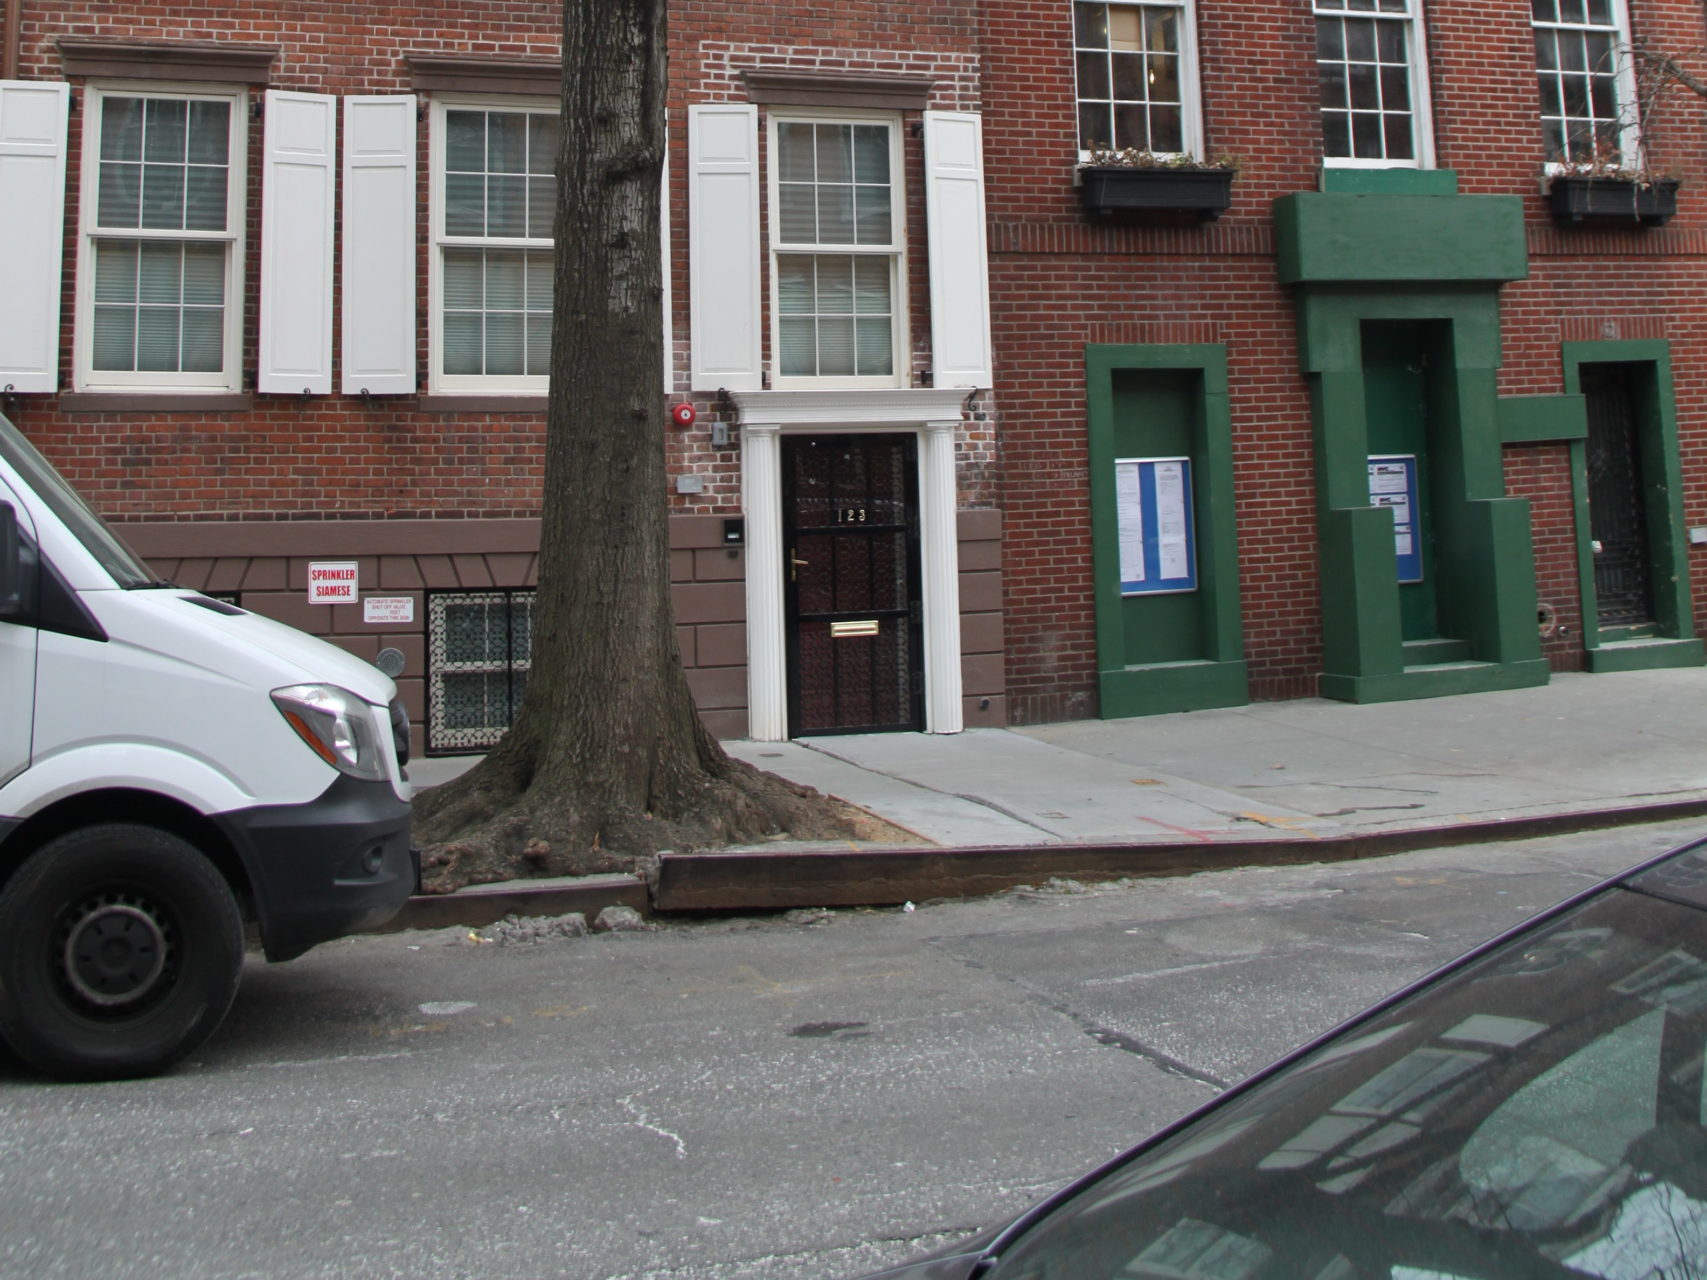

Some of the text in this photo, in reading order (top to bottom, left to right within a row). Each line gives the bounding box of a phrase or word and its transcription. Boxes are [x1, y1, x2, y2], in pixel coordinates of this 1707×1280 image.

[837, 509, 866, 522] 123
[312, 569, 355, 581] SPRINKLER
[316, 585, 351, 596] SIAMESE
